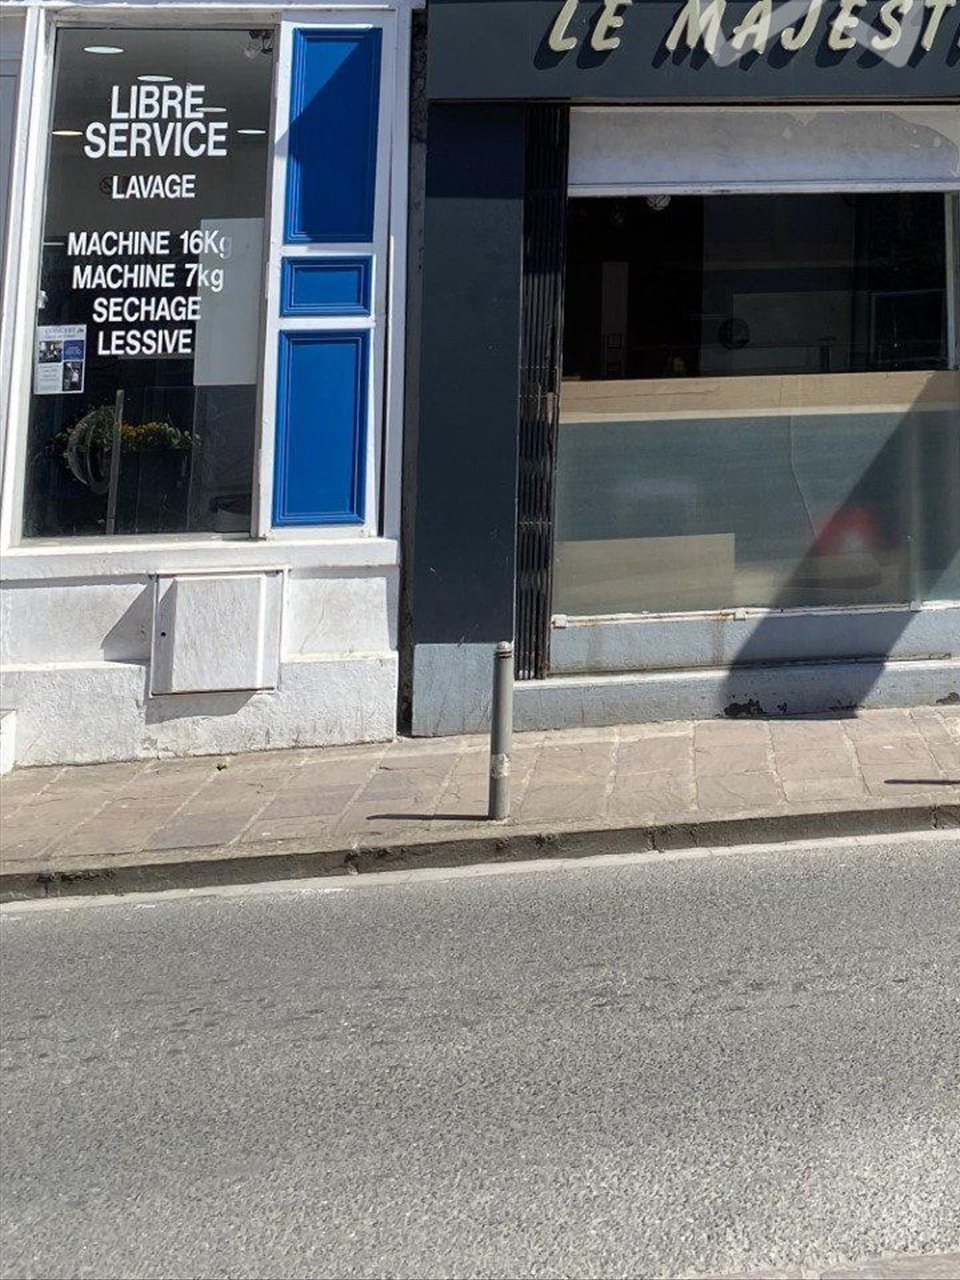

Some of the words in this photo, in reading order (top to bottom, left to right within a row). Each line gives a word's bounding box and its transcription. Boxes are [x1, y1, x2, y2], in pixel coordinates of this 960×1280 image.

[111, 85, 206, 119] LIBRE
[84, 122, 228, 158] SERVICE
[112, 174, 196, 199] LAVAGE
[68, 231, 169, 256] MACHINE
[180, 231, 232, 258] 16Kg
[72, 264, 174, 289] MACHINE
[93, 297, 201, 322] SECHAGE
[98, 331, 191, 355] LESSIVE
